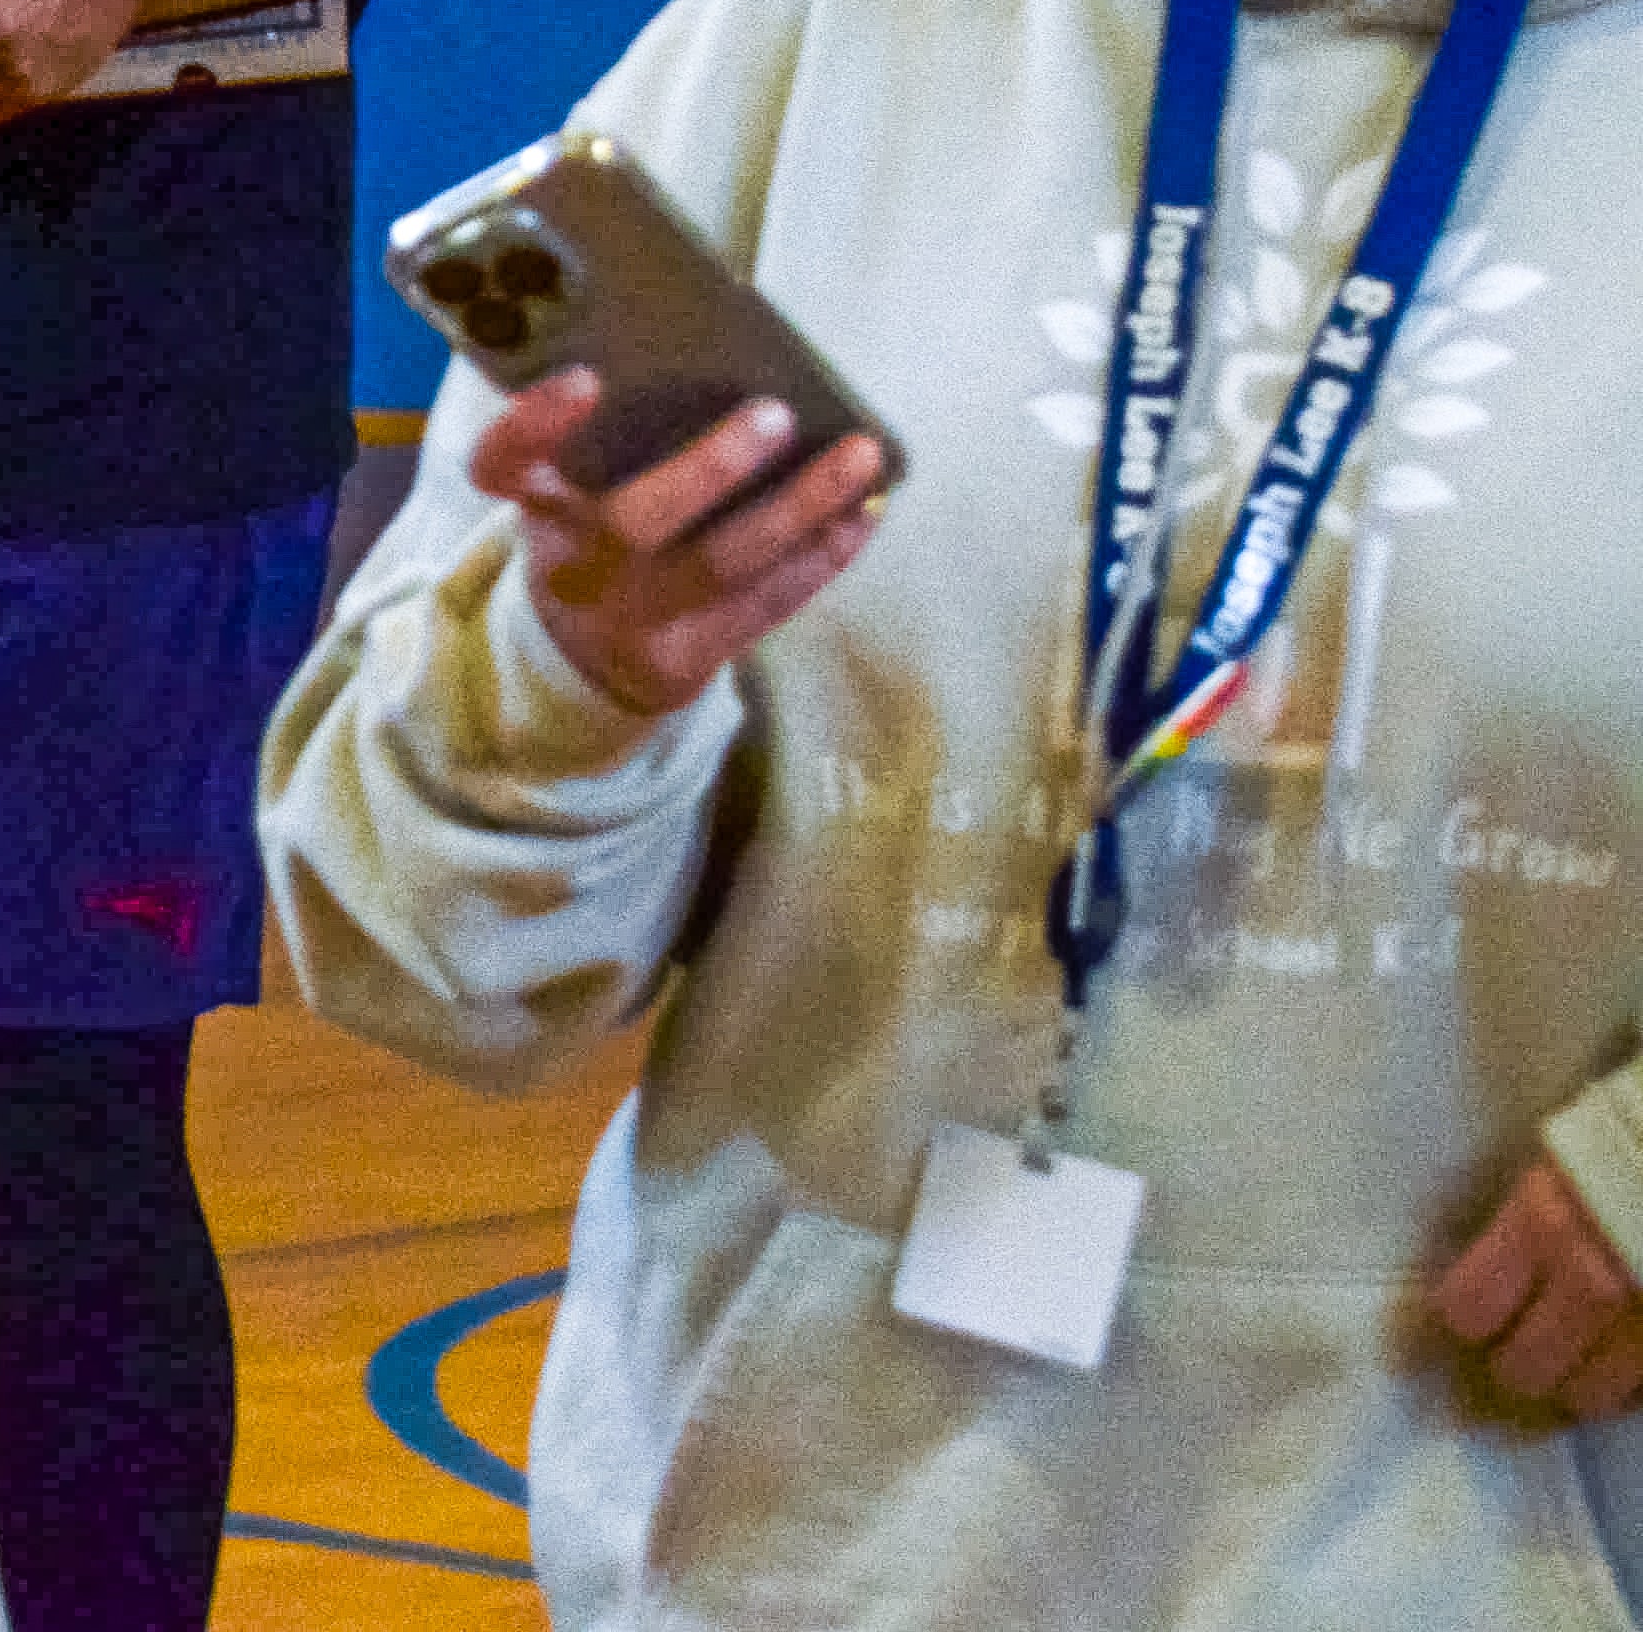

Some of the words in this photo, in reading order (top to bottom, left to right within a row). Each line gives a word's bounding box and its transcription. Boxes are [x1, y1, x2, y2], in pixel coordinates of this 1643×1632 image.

[1127, 204, 1201, 384] Joseph
[1115, 396, 1175, 492] Lee
[1191, 483, 1307, 654] Joseph
[1267, 377, 1353, 476] Lee
[1314, 275, 1395, 372] K-8
